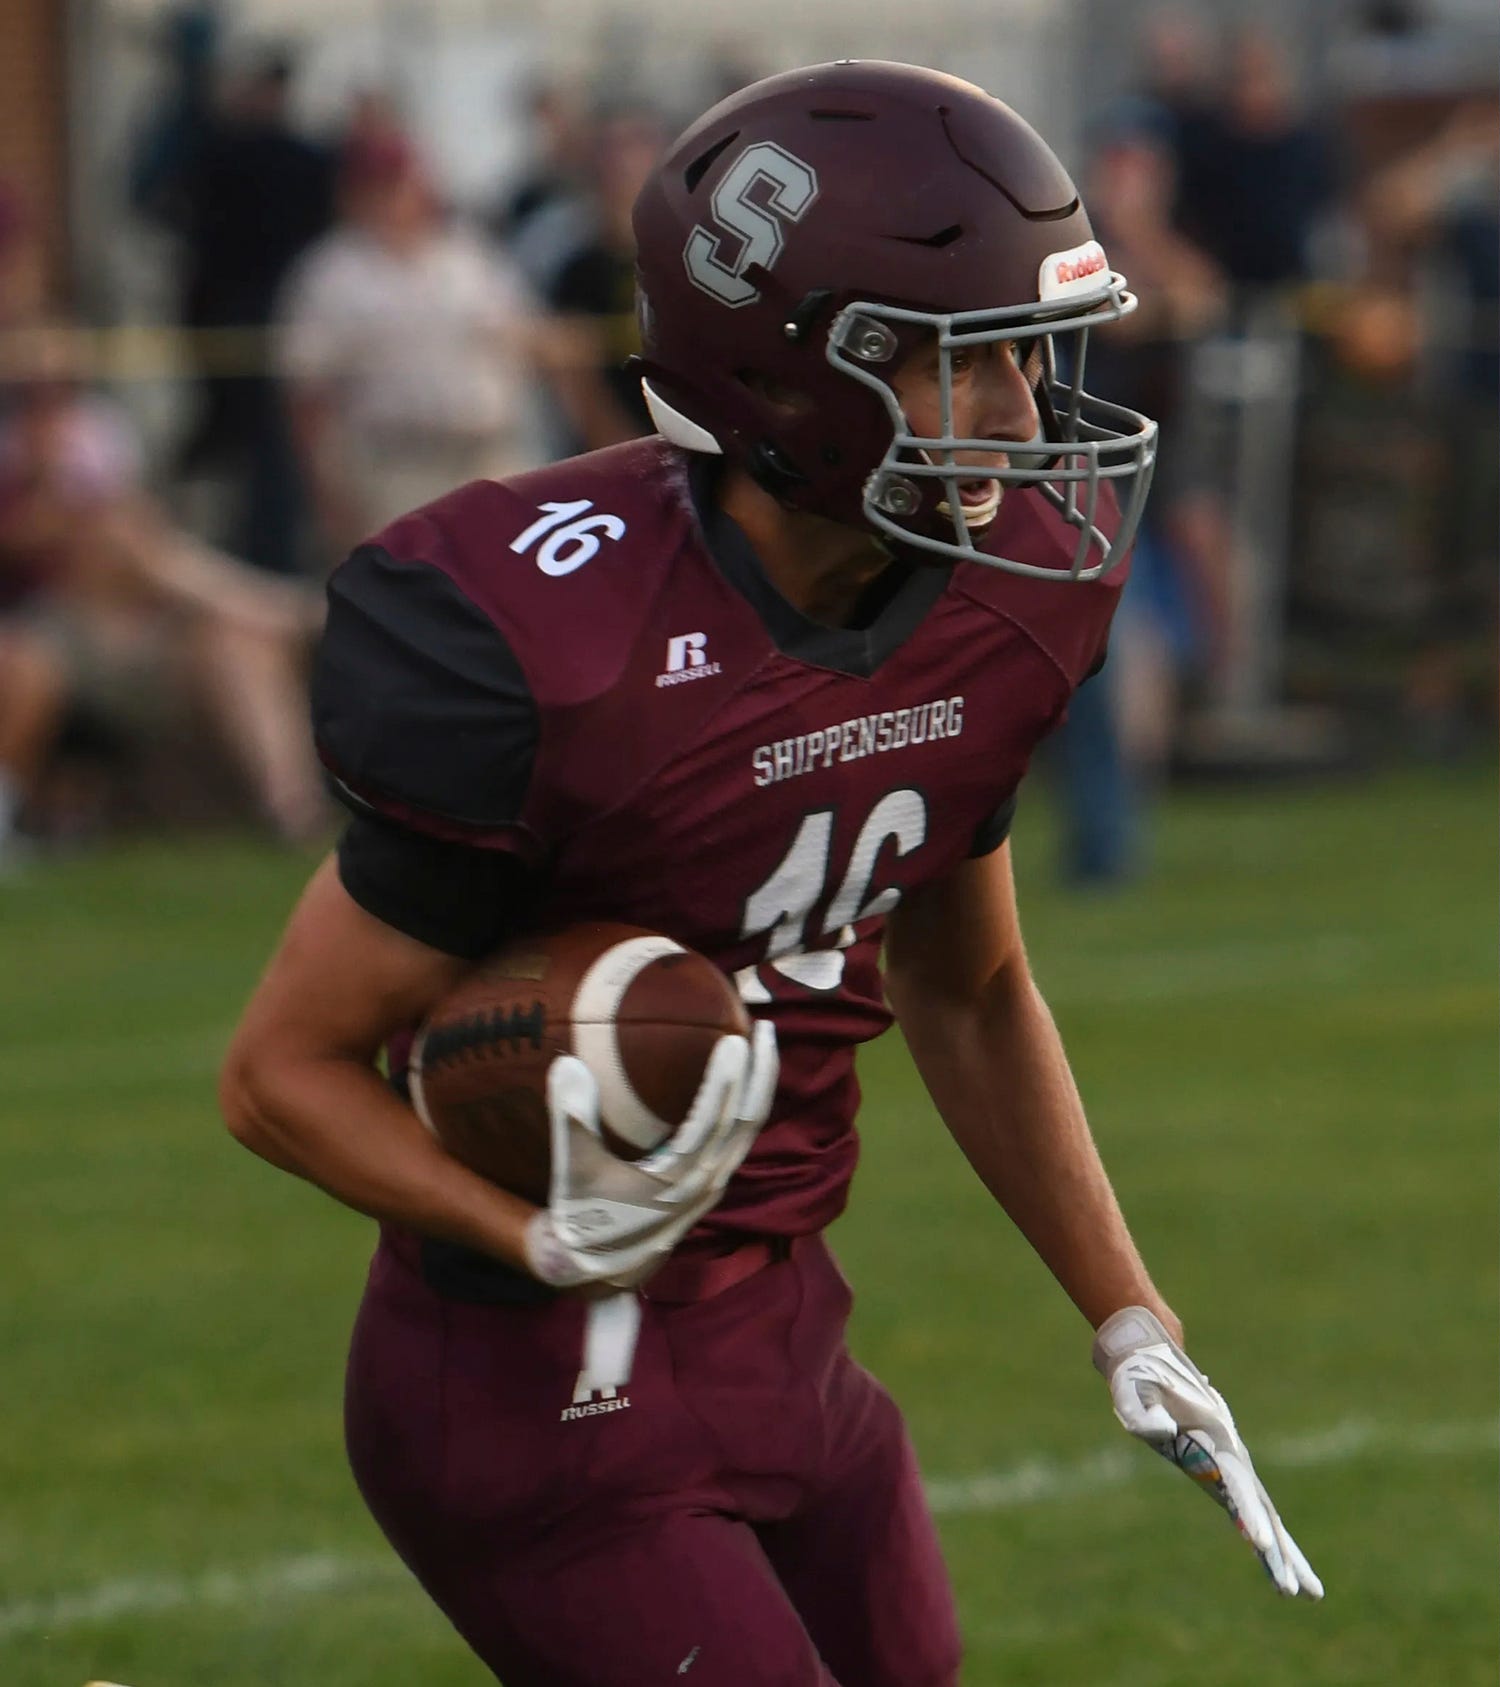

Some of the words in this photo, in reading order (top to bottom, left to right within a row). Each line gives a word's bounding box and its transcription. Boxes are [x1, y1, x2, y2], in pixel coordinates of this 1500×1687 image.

[682, 141, 819, 309] S
[509, 499, 626, 577] 16
[655, 661, 723, 688] RUSSELL
[666, 632, 708, 672] R
[752, 696, 964, 787] SHIPPENSBURG
[738, 788, 926, 1003] 16
[560, 1397, 632, 1421] RUSSELL
